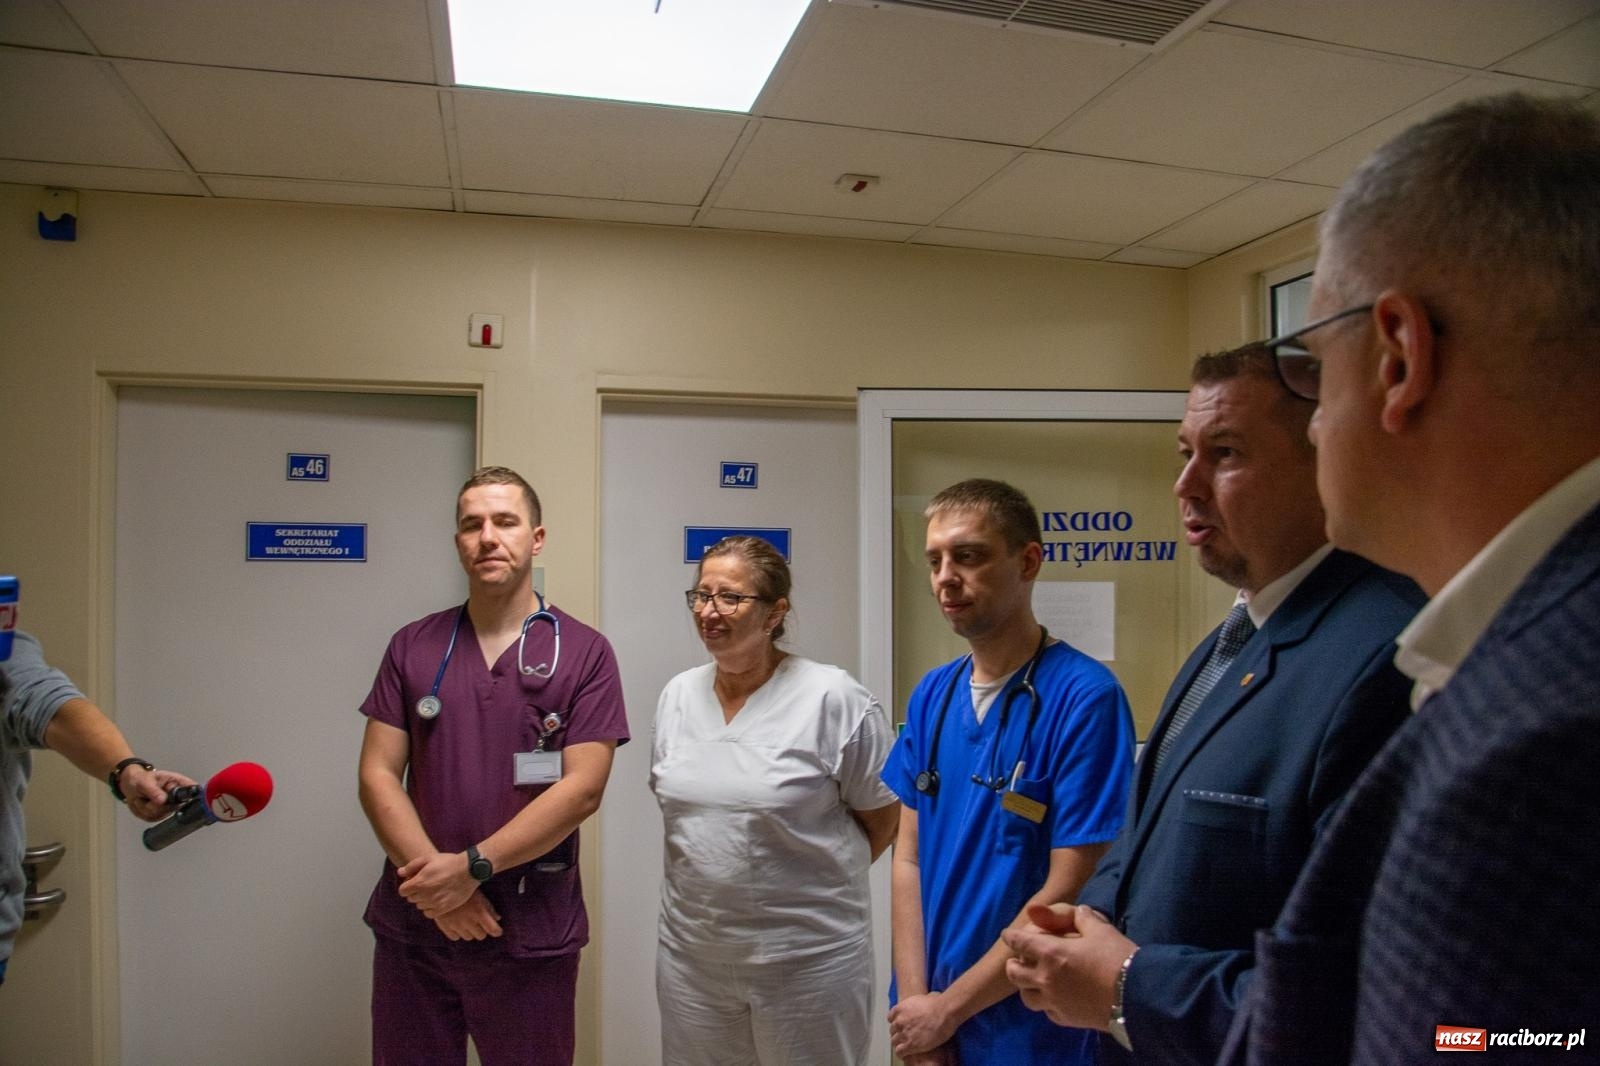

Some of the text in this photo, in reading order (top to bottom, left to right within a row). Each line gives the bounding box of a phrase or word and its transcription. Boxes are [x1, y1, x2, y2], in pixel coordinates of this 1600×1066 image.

[291, 459, 324, 477] AS 46
[724, 467, 753, 484] AS 47
[275, 529, 340, 537] SEKRETARIAT
[283, 538, 332, 546] ODDZIAŁU
[265, 547, 343, 556] WEWNĘTRZNEGO
